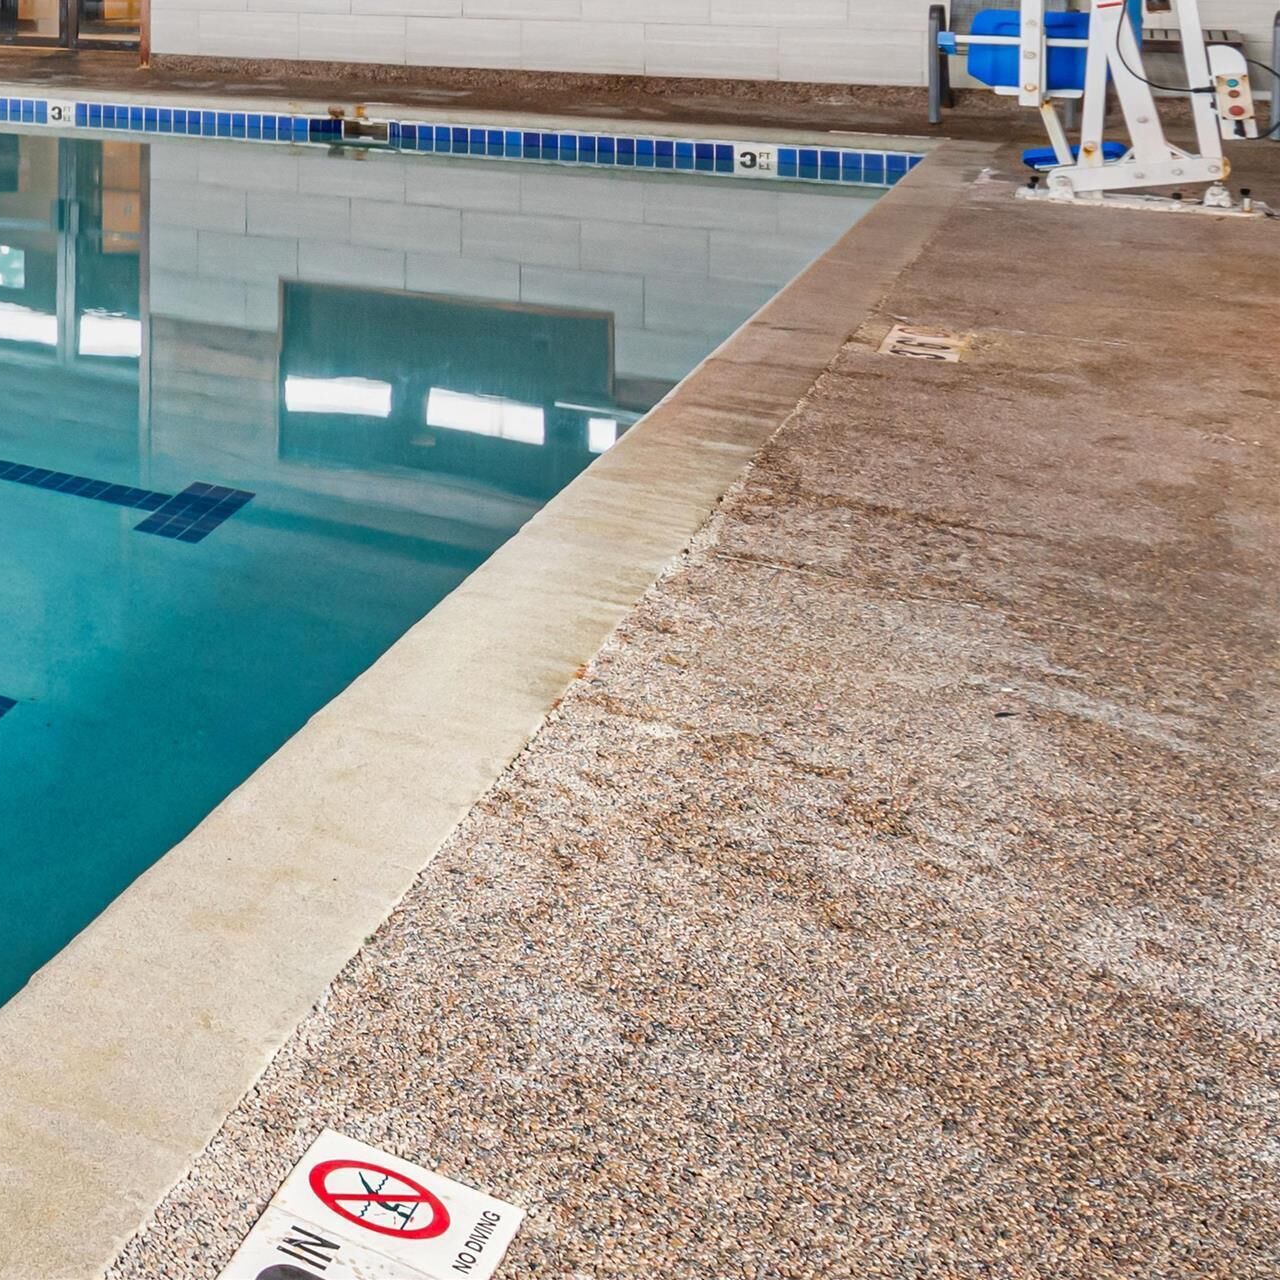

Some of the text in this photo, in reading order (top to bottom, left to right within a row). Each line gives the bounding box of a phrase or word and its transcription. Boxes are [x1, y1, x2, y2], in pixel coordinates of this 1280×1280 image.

[740, 151, 757, 169] 3
[276, 1225, 341, 1271] IN
[451, 1210, 501, 1275] NO DIVING
